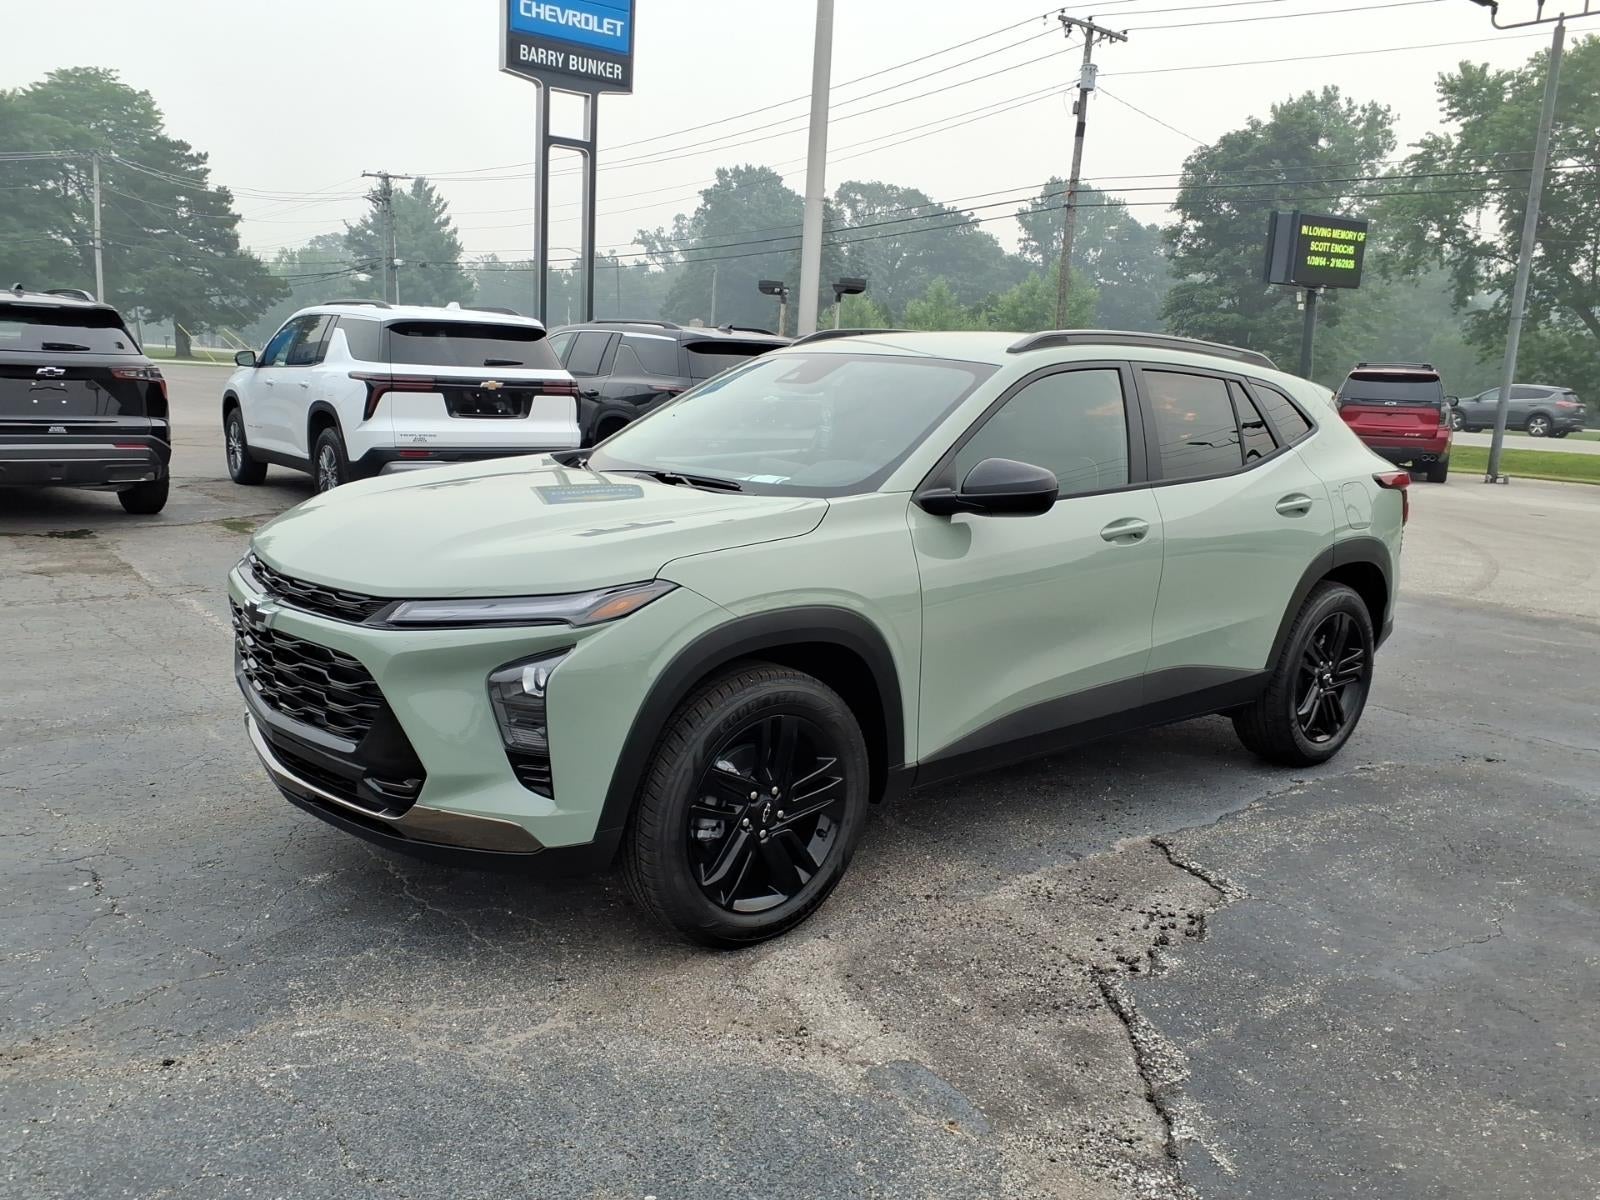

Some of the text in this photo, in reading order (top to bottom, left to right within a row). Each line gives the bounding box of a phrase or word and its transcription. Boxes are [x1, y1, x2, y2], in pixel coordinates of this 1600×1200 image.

[519, 0, 625, 37] CHEVROLET
[519, 44, 622, 80] BARRY BUNKER
[1301, 225, 1366, 241] IN LOVING MEMORY OF
[1310, 241, 1330, 251] SCOTT
